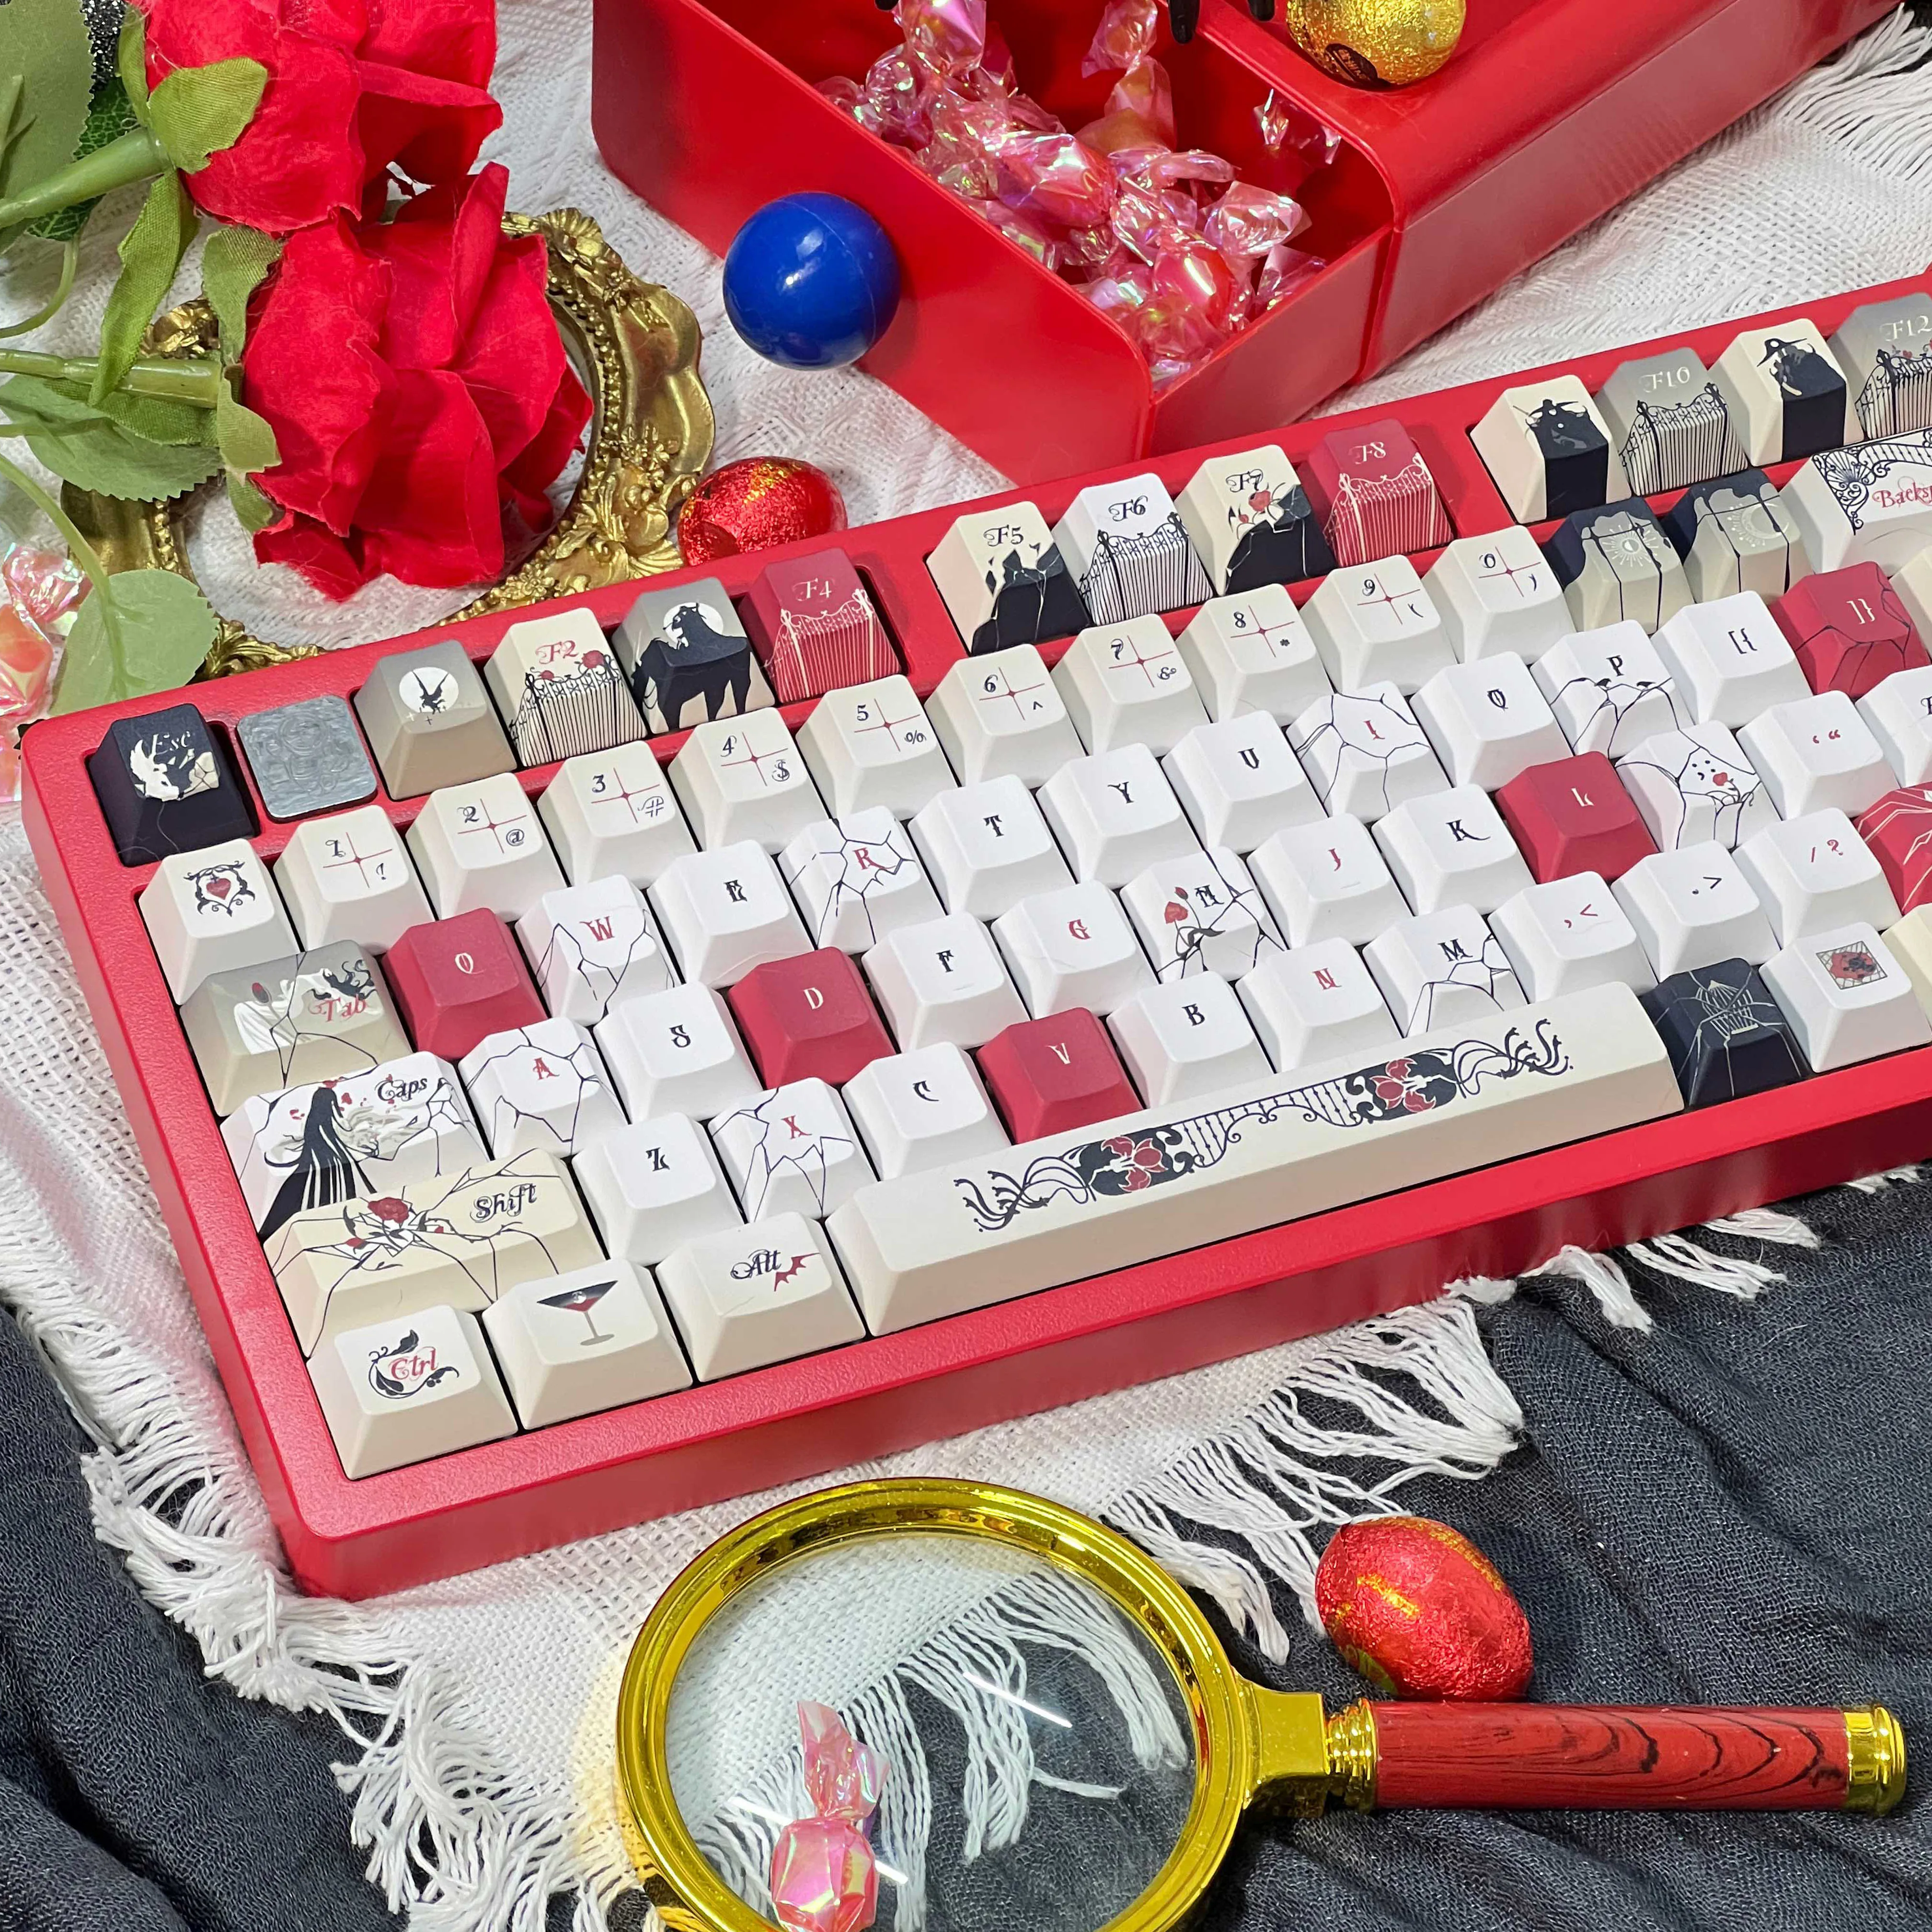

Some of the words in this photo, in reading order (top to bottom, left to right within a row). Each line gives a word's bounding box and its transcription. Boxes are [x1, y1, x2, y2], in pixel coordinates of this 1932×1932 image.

[1881, 314, 1932, 342] F12
[1640, 366, 1690, 390] F10
[1348, 441, 1387, 465] F8
[1225, 468, 1265, 493] F7
[1108, 494, 1148, 522] F6
[983, 525, 1024, 547] F5
[793, 578, 832, 600] F4
[1361, 579, 1376, 597] 9
[1233, 611, 1246, 629] 8
[535, 640, 578, 666] F2
[1110, 638, 1124, 660] 7
[1606, 655, 1624, 677] P
[983, 674, 999, 693] 6
[857, 704, 870, 722] 5
[151, 731, 191, 756] Esc
[720, 735, 737, 758] 4
[904, 730, 927, 745] %
[771, 759, 791, 783] $
[1237, 748, 1261, 770] U
[592, 774, 606, 794] 3
[1107, 781, 1134, 804] Y
[457, 806, 480, 823] 2
[637, 795, 665, 817] #
[505, 828, 525, 846] @
[983, 815, 1005, 838] T
[1445, 819, 1492, 843] K
[853, 847, 897, 871] R
[1328, 848, 1342, 872] J
[724, 879, 748, 903] E
[580, 916, 615, 942] W
[1067, 918, 1092, 941] G
[935, 949, 954, 974] F
[1437, 938, 1474, 962] M
[1311, 967, 1342, 991] N
[308, 994, 368, 1023] Tab
[803, 987, 824, 1010] D
[1181, 1003, 1206, 1027] B
[669, 1024, 691, 1048] S
[1046, 1042, 1072, 1065] V
[532, 1057, 560, 1080] A
[374, 1074, 428, 1102] Caps
[912, 1080, 940, 1102] C
[781, 1114, 813, 1139] X
[647, 1146, 670, 1172] Z
[470, 1182, 537, 1223] Shift
[730, 1249, 782, 1280] Alt
[388, 1346, 438, 1381] Ctrl
